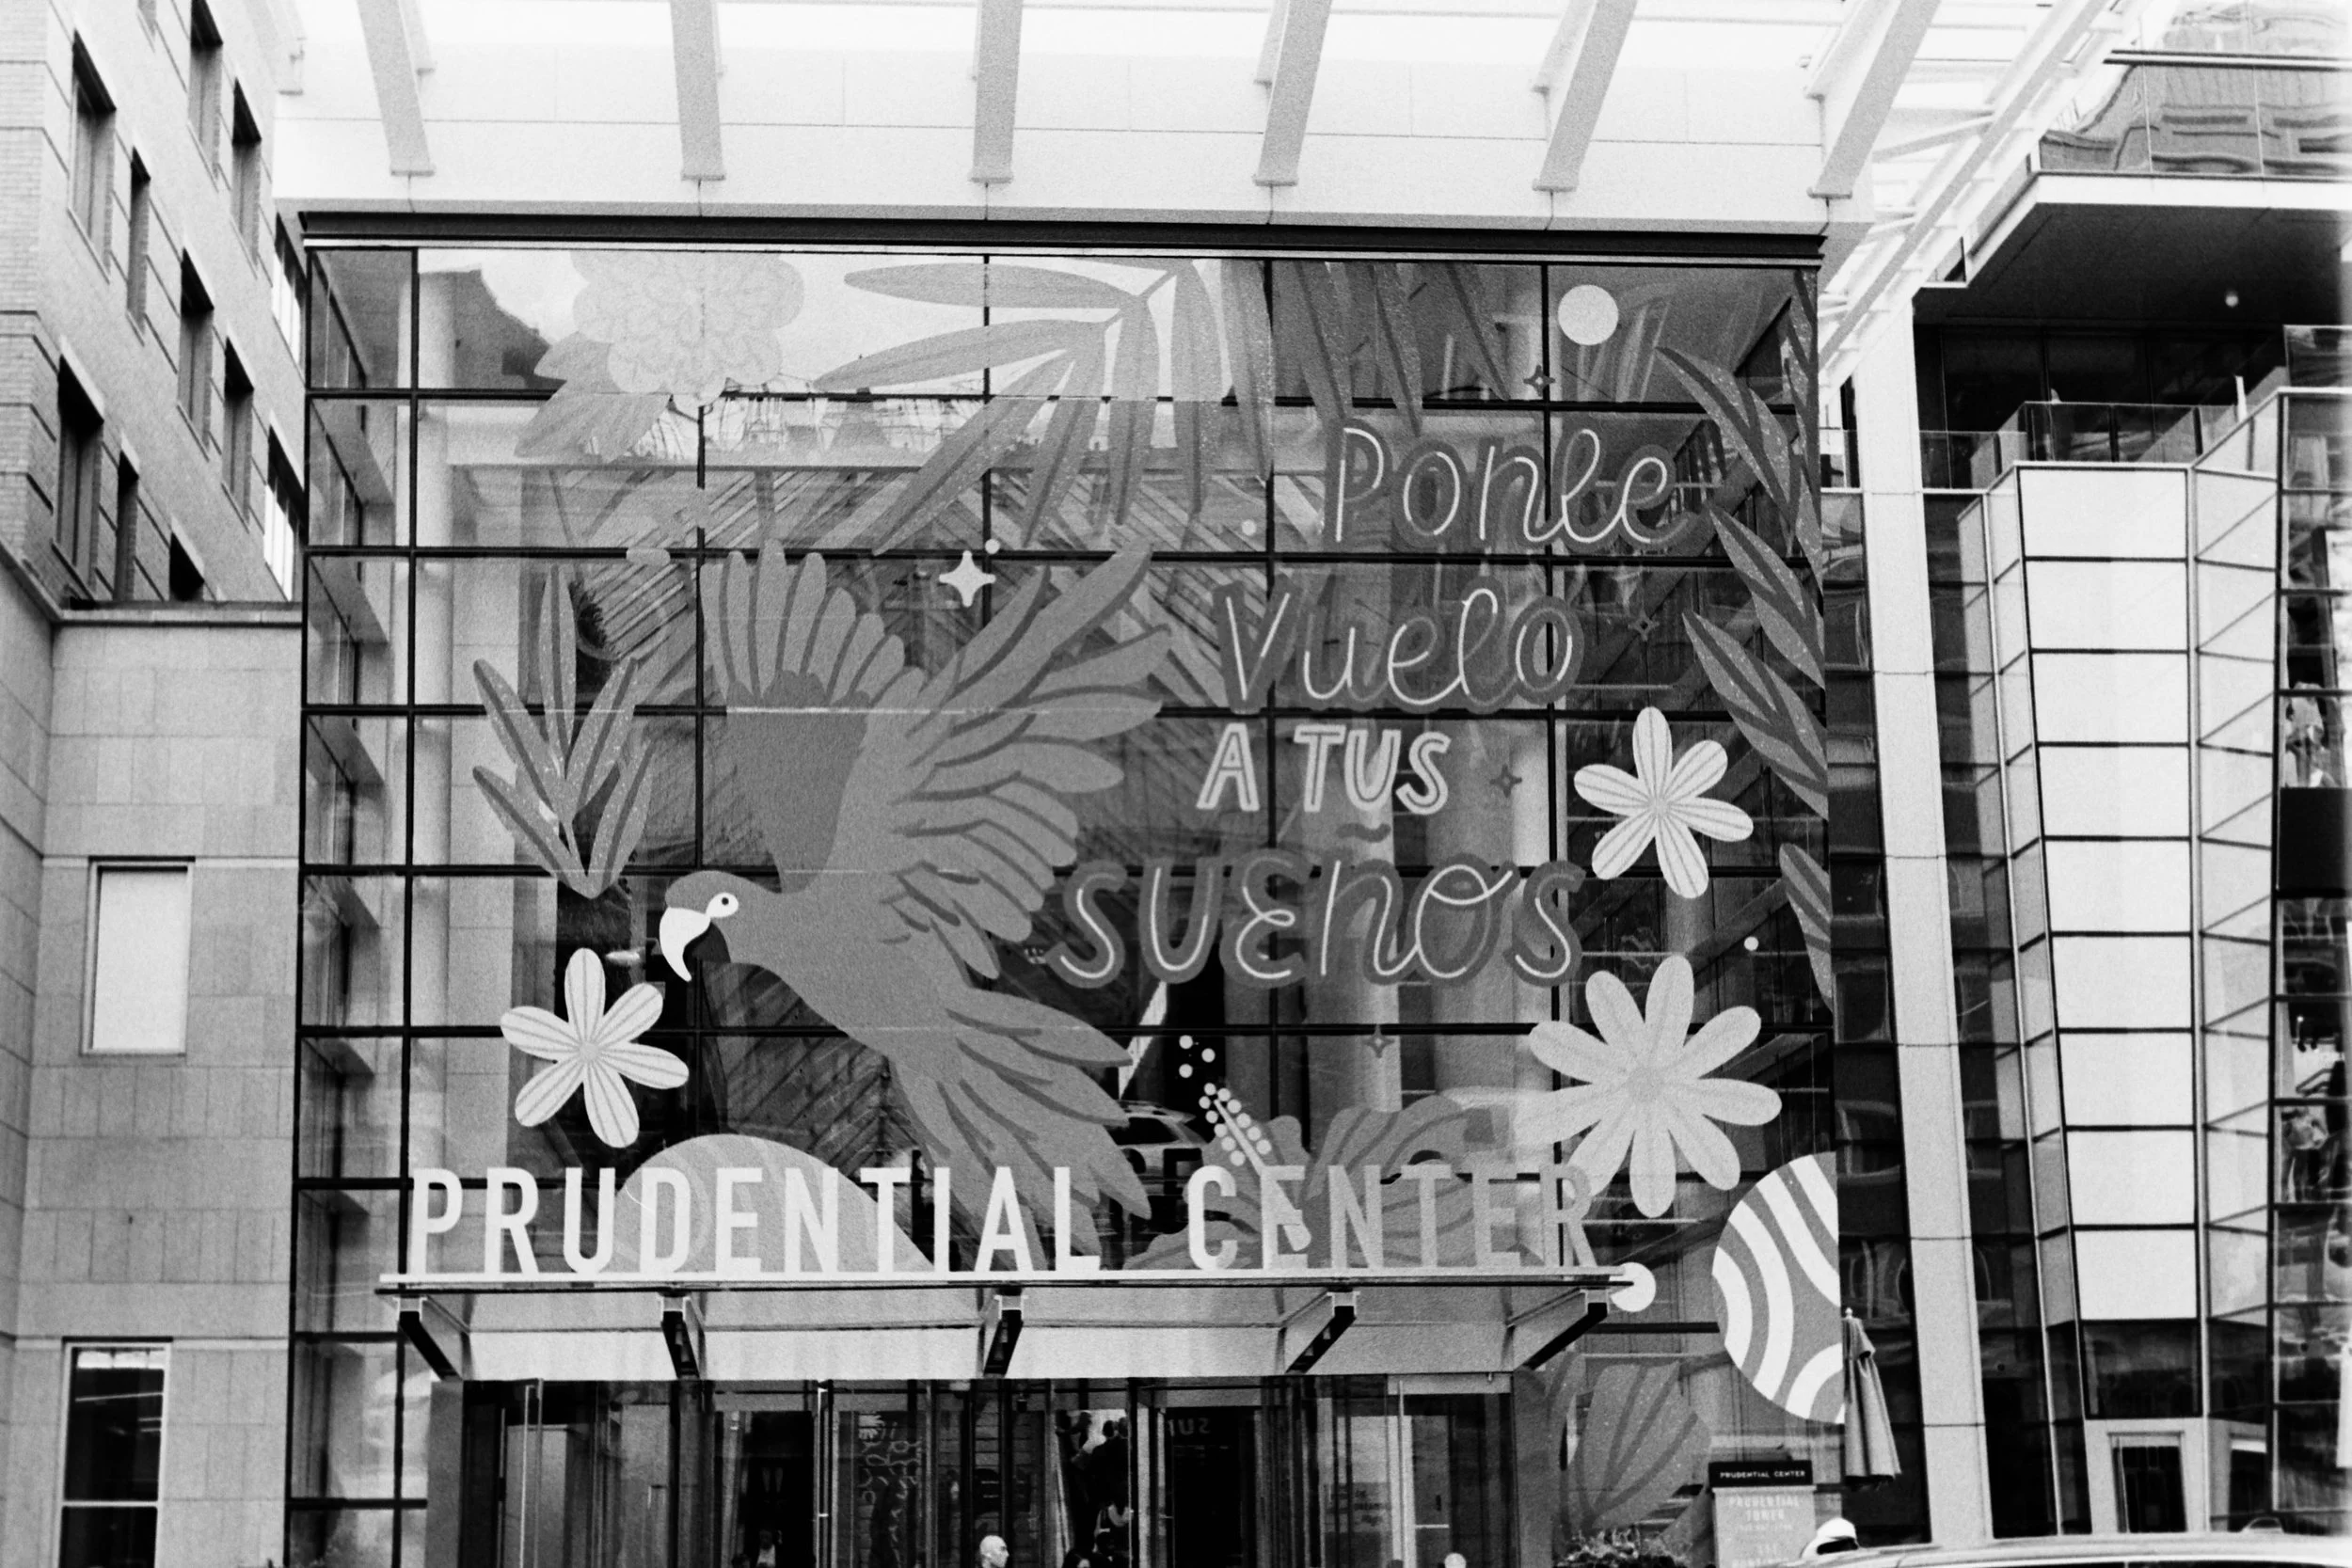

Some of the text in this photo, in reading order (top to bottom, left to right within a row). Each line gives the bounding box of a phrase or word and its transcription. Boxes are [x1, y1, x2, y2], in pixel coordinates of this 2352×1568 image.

[1196, 722, 1452, 816] A TUS
[409, 1164, 1597, 1274] PRUDENTIAL CENTER
[1720, 1469, 1805, 1479] PRUDENTIAL CENTER
